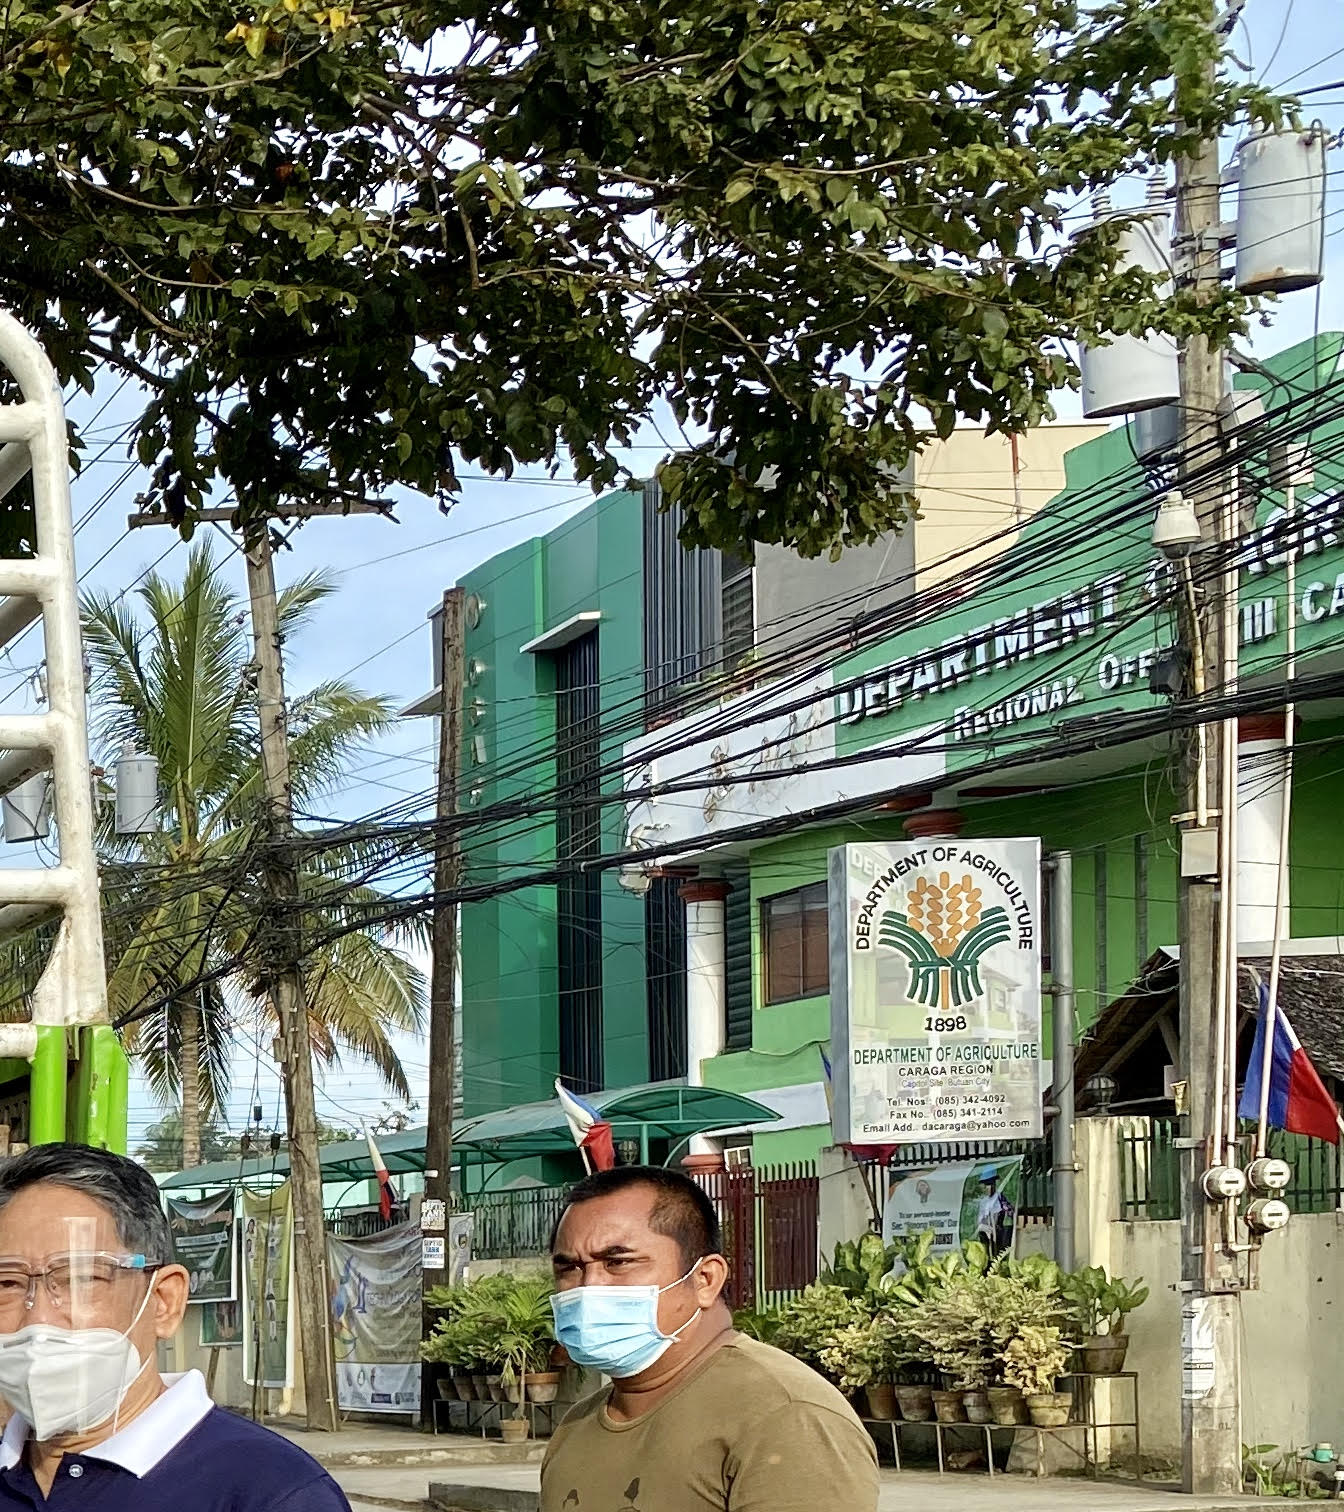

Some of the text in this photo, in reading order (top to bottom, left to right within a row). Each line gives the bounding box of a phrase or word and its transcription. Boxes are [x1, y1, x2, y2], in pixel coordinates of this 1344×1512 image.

[838, 571, 1128, 726] DEPARTMENT
[953, 675, 1084, 741] REGIONAL
[855, 846, 1033, 951] DEPARTMENT OF AGRICULTURE
[923, 1015, 967, 1033] 1898
[854, 1043, 1038, 1065] DEPARTMENT OF AGRICULTURE
[898, 1064, 994, 1077] CARAGA REGION
[975, 1076, 990, 1087] City
[935, 1096, 959, 1106] (085)
[962, 1094, 1006, 1105] 342-4092
[890, 1110, 907, 1120] Fax
[960, 1107, 1003, 1118] 341-2114
[863, 1123, 890, 1133] Email
